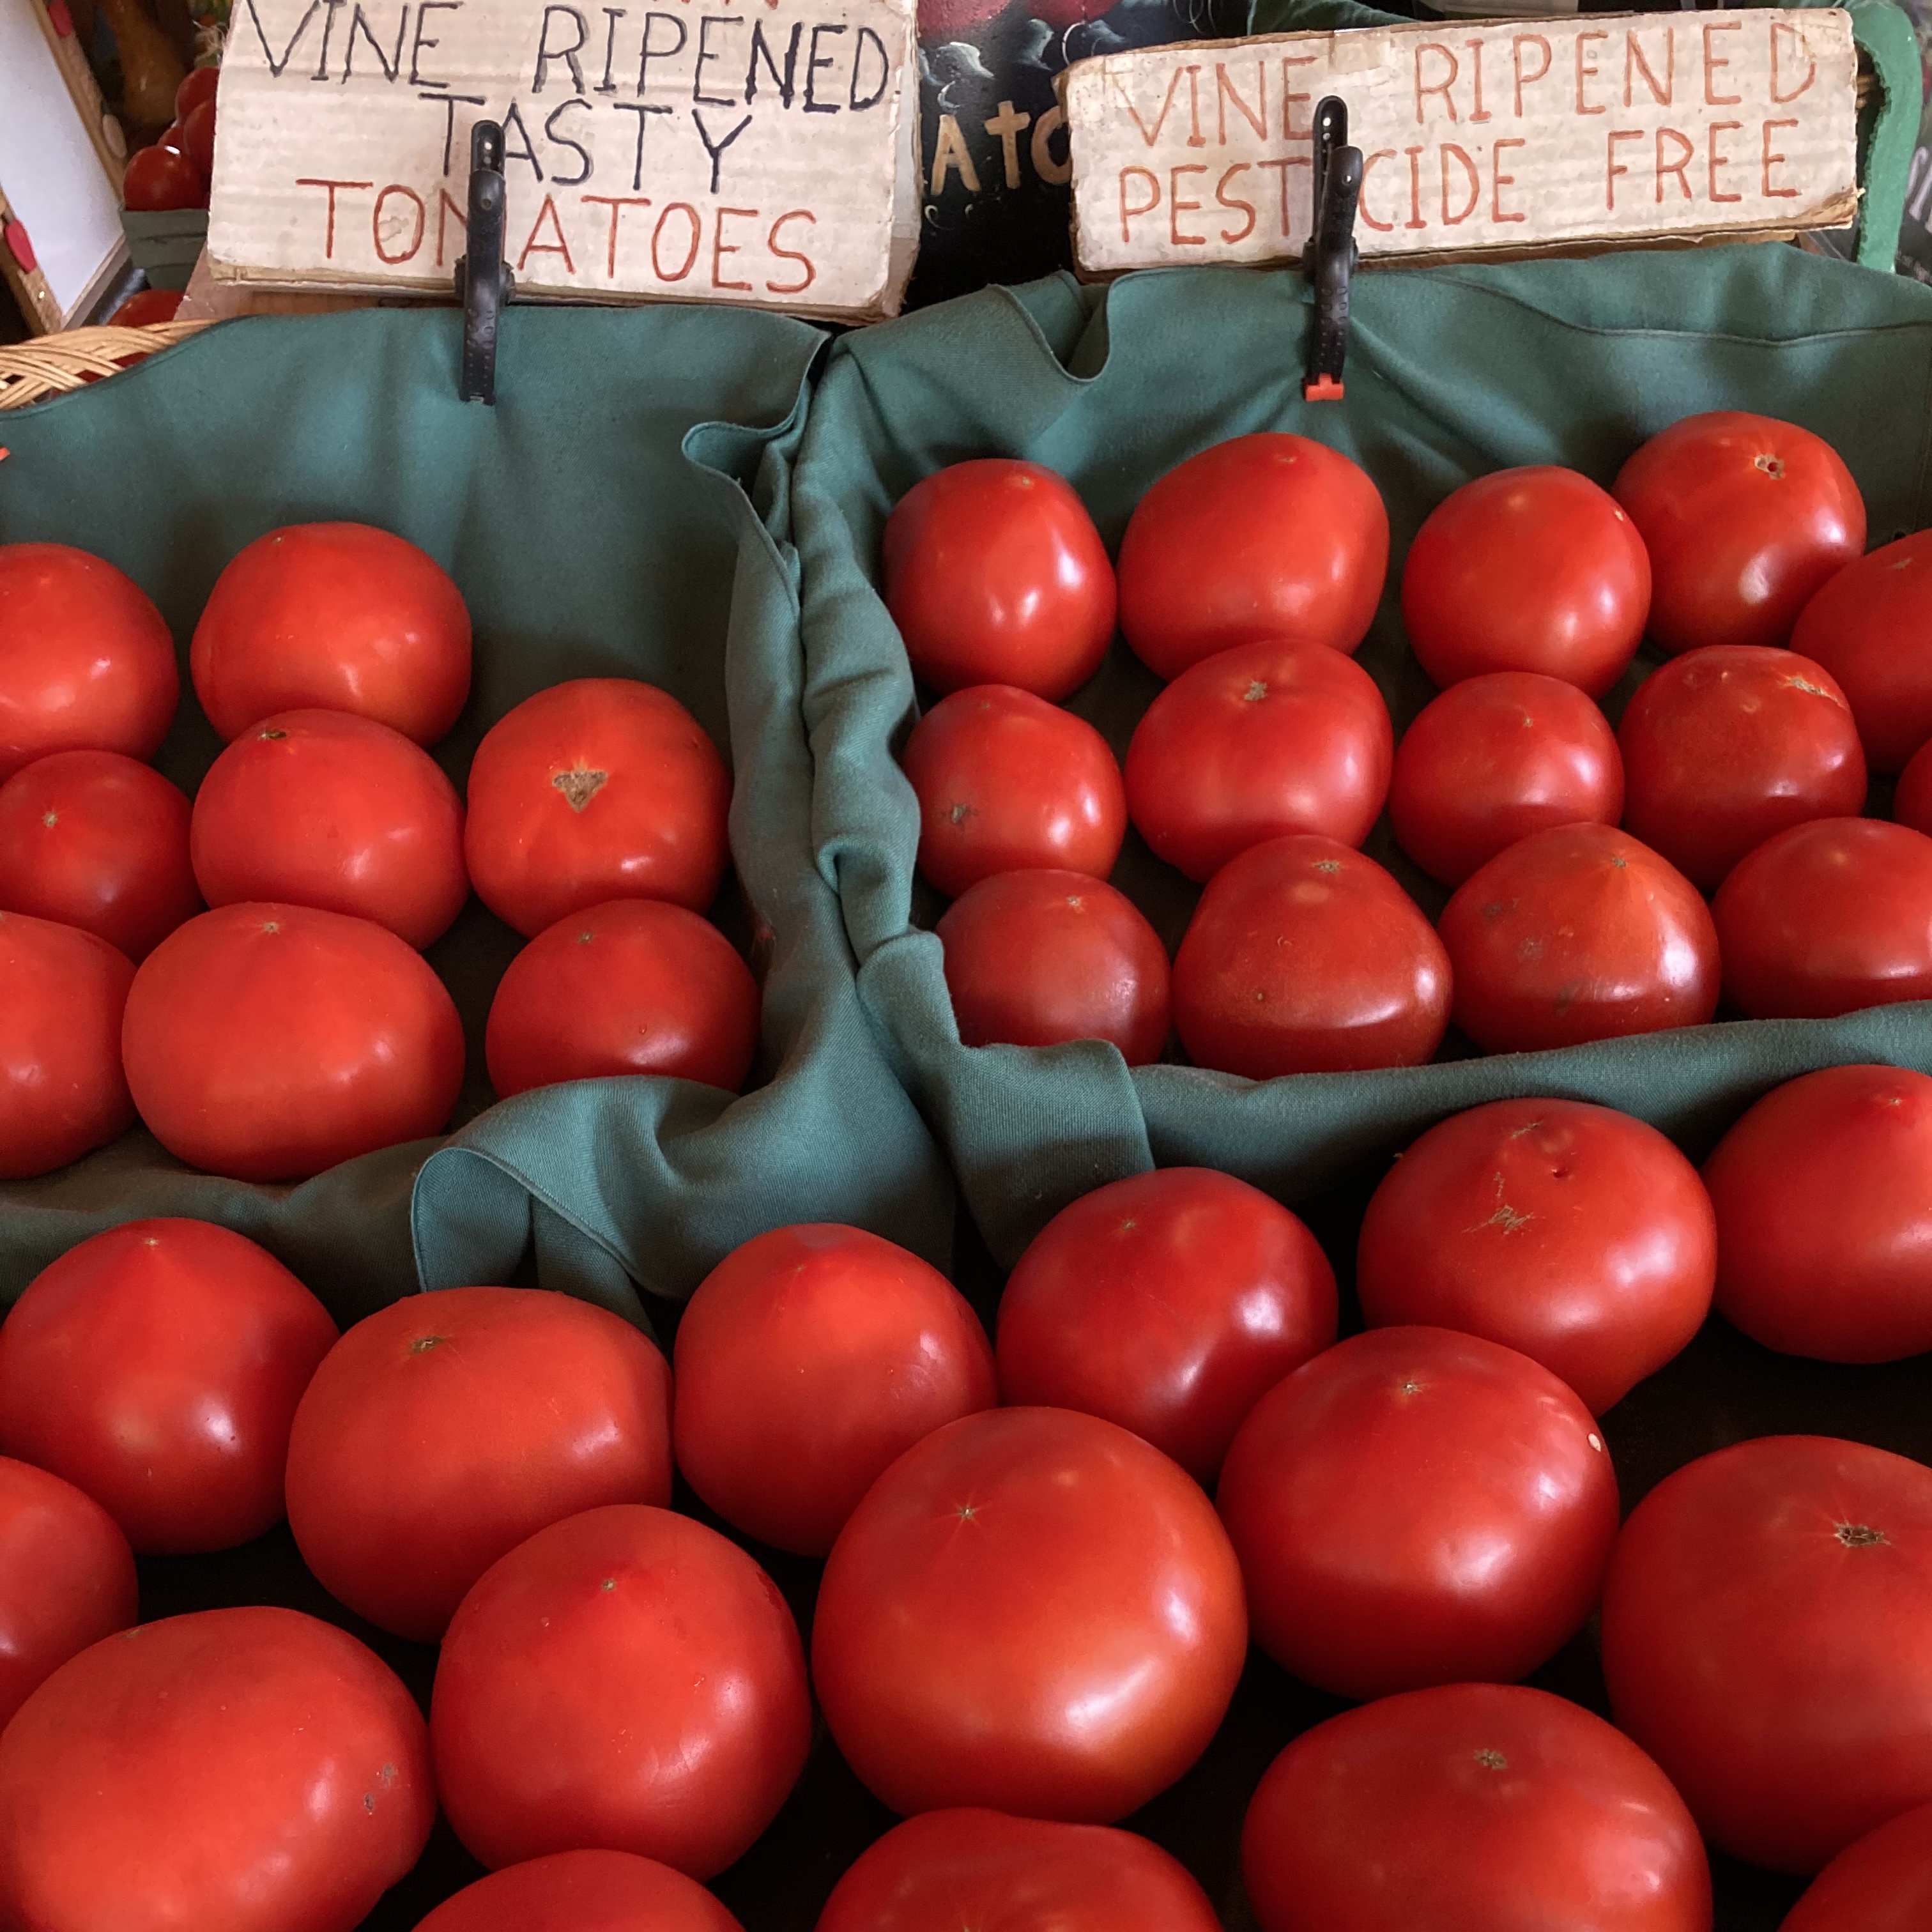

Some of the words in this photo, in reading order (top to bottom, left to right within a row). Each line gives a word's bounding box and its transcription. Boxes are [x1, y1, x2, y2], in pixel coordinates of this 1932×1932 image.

[245, 0, 460, 88] VINE
[532, 5, 889, 113] RIPENED
[1112, 55, 1317, 148] VINE
[1414, 21, 1816, 125] RIPENED
[418, 93, 753, 194] TASTY
[1119, 138, 1526, 245] PESTCIDE
[1607, 118, 1802, 210] FREE
